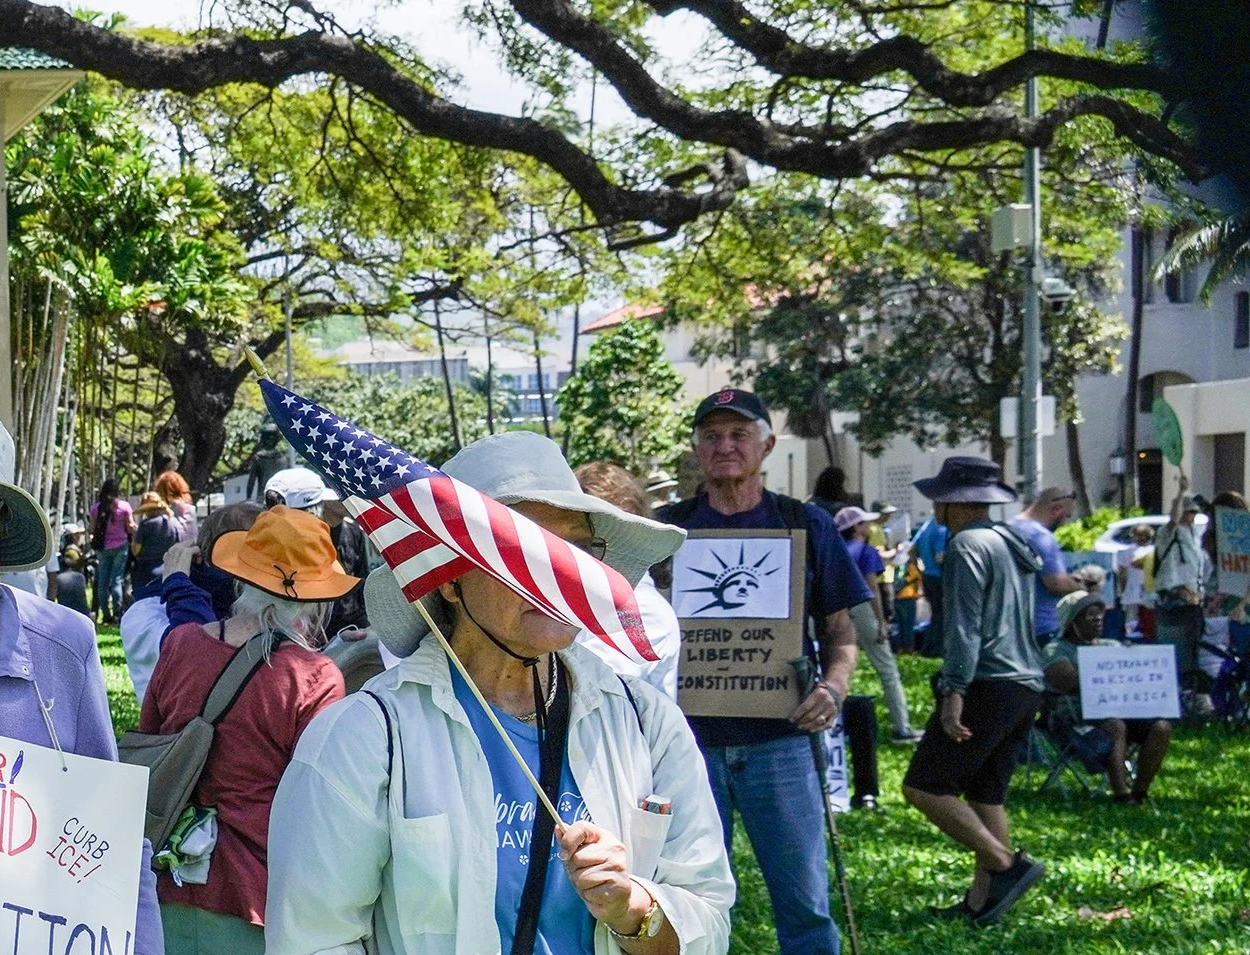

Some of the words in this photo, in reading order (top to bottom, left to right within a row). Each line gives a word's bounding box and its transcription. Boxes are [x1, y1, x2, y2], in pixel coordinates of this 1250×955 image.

[715, 391, 734, 405] B
[680, 627, 733, 643] DEFEND
[741, 627, 775, 641] OUR
[687, 648, 772, 663] LIBERTY
[678, 674, 789, 692] CONSTITUTION
[63, 817, 110, 860] CURB
[46, 836, 102, 884] ICE!
